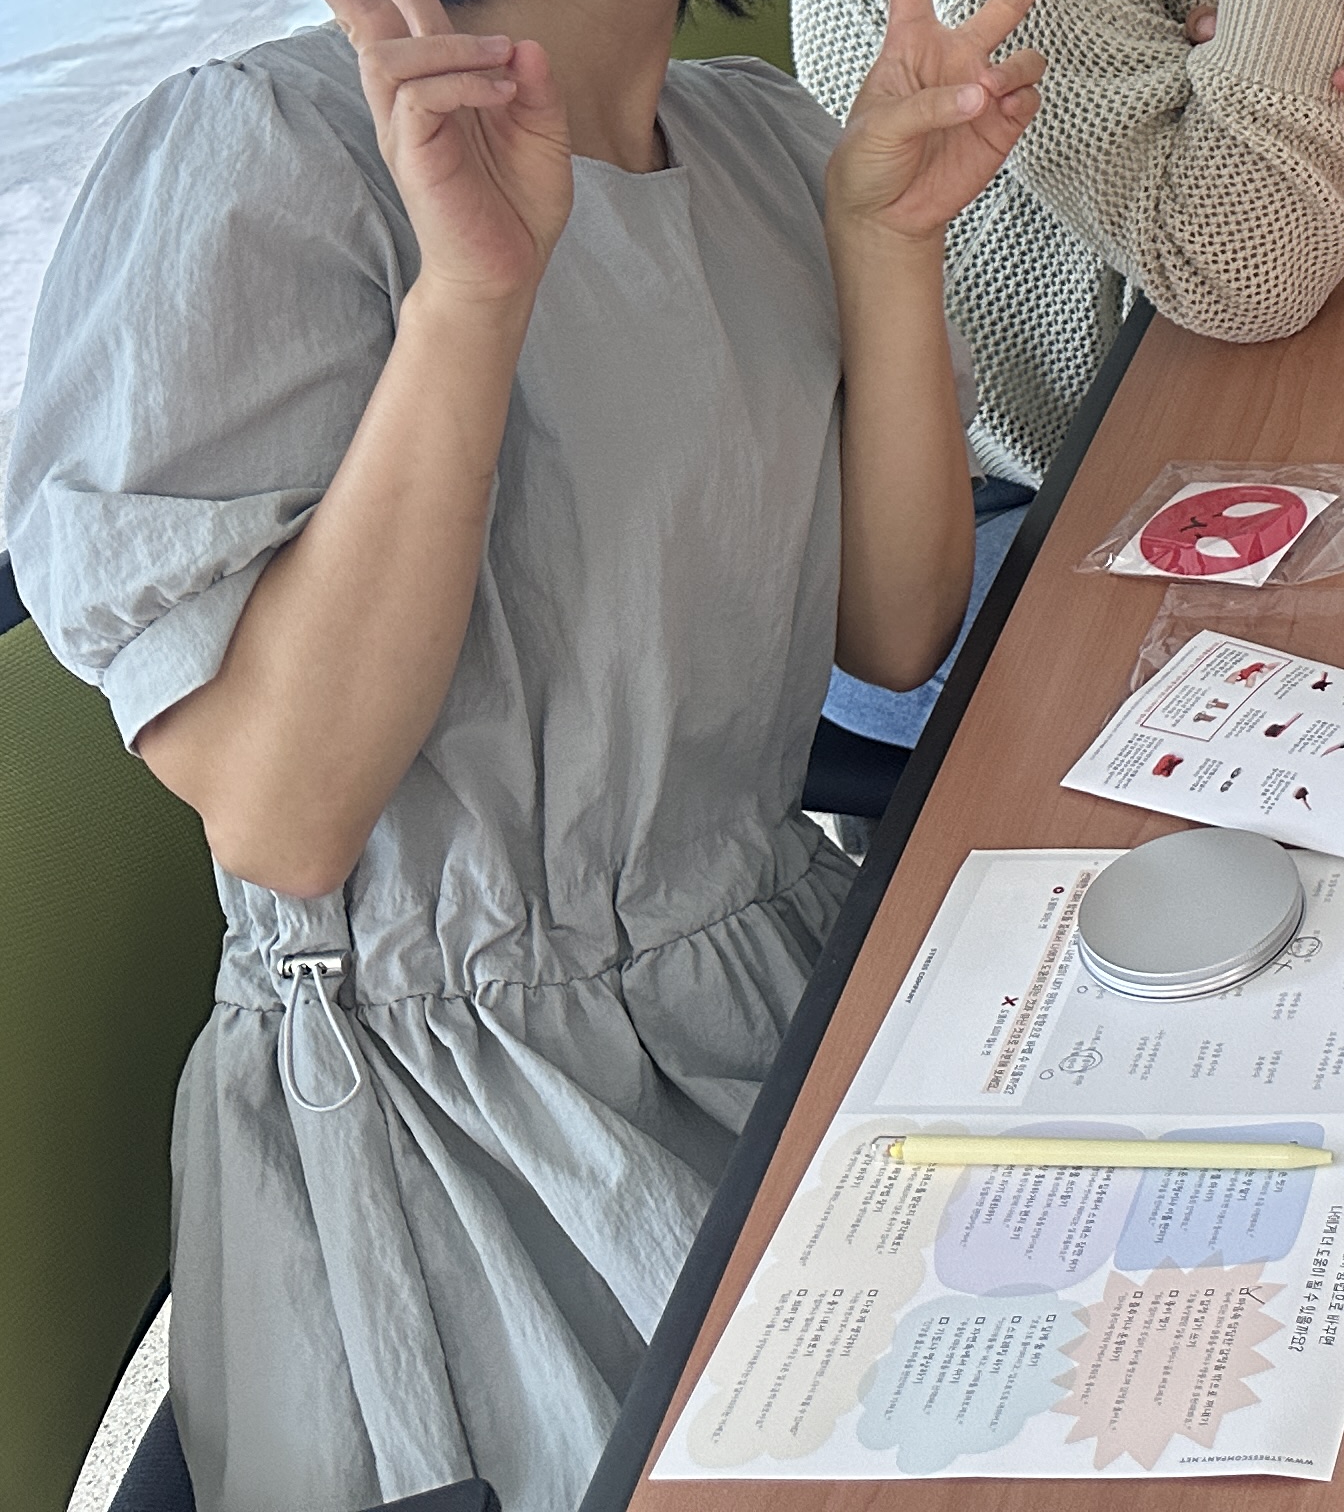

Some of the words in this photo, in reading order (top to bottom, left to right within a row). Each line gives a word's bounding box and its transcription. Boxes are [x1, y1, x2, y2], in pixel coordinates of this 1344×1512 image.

[920, 947, 938, 970] STRESS
[903, 971, 927, 1003] COMPANY
[1318, 1236, 1336, 1245] 더
[1308, 1247, 1333, 1276] 도움이
[1301, 1292, 1320, 1302] 수
[1305, 1279, 1324, 1289] 될
[1286, 1305, 1317, 1352] 있을까요?
[1316, 1314, 1341, 1346] 바꾸면
